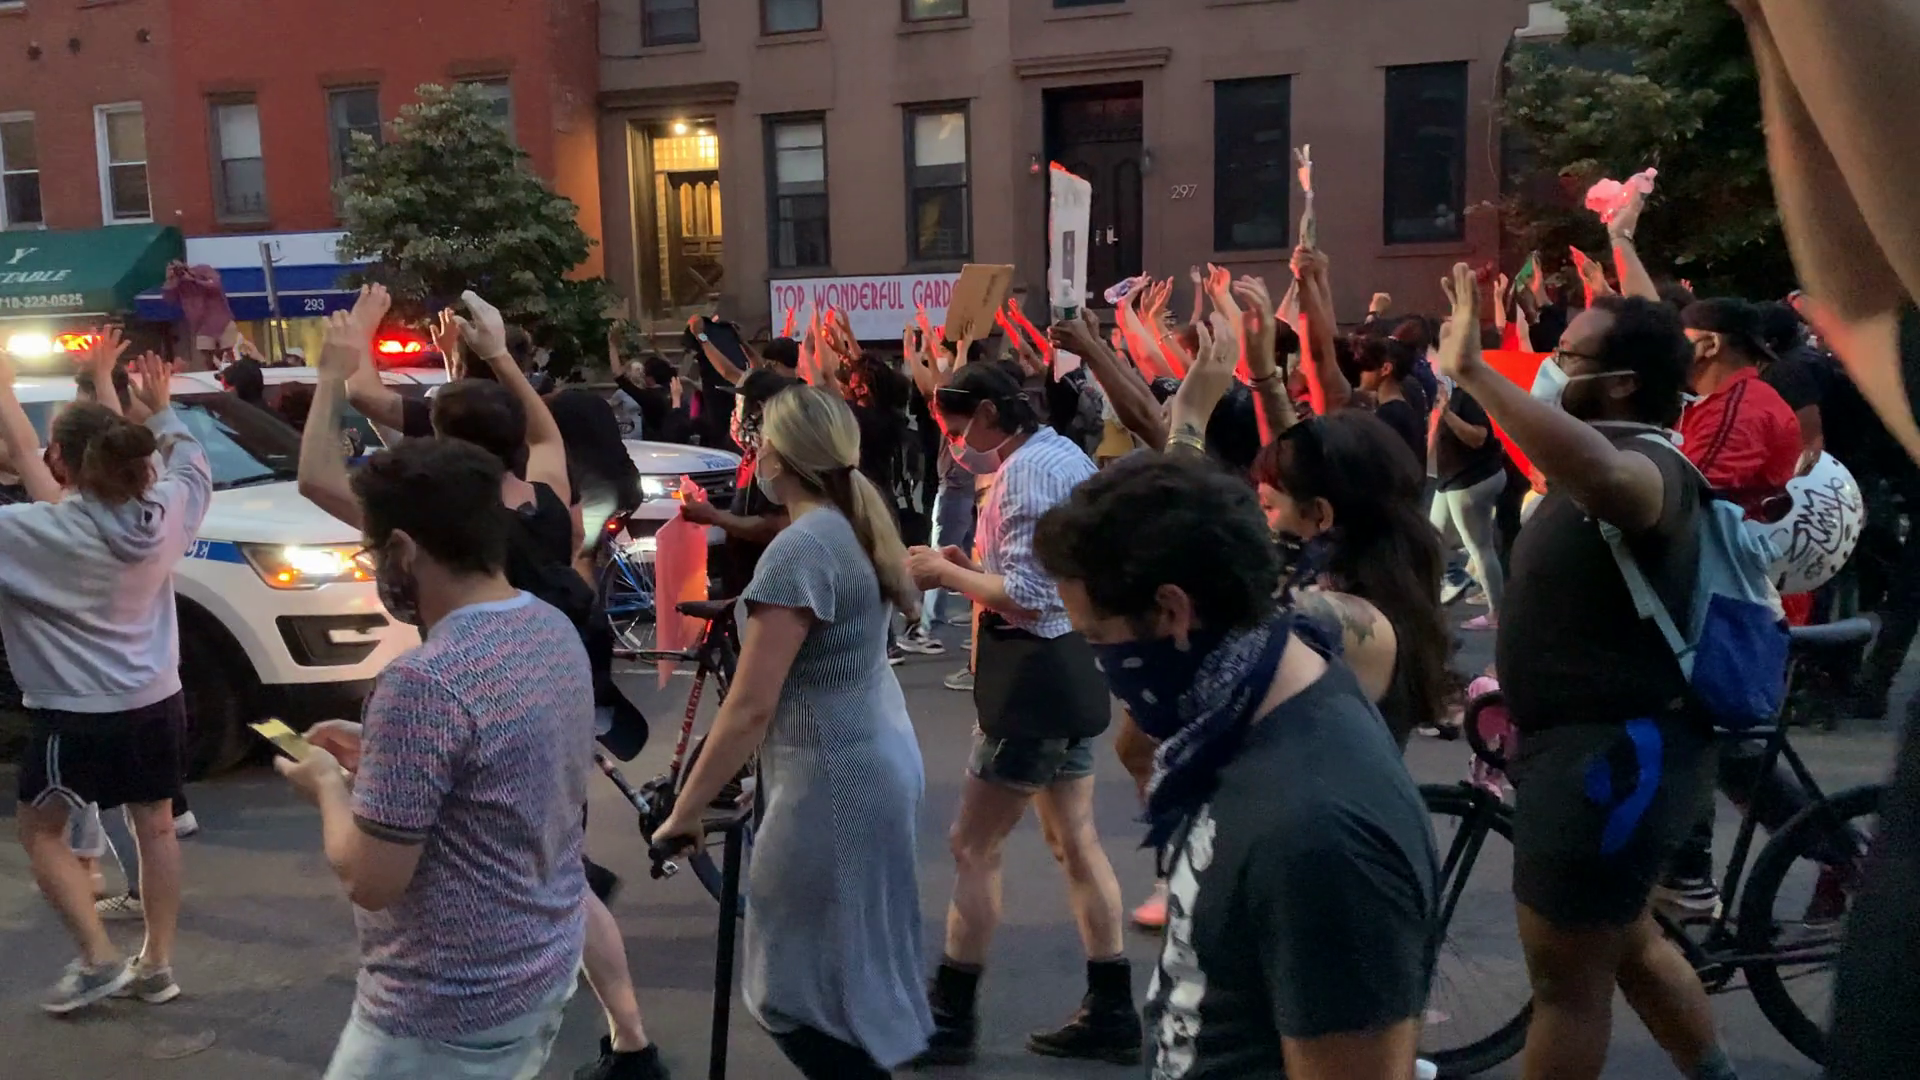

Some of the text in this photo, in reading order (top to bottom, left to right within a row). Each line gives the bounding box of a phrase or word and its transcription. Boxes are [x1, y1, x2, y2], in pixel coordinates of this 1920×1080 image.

[1171, 184, 1197, 199] 297
[775, 285, 805, 312] TOP
[813, 281, 904, 311] WONDERFUL
[304, 298, 325, 311] 293
